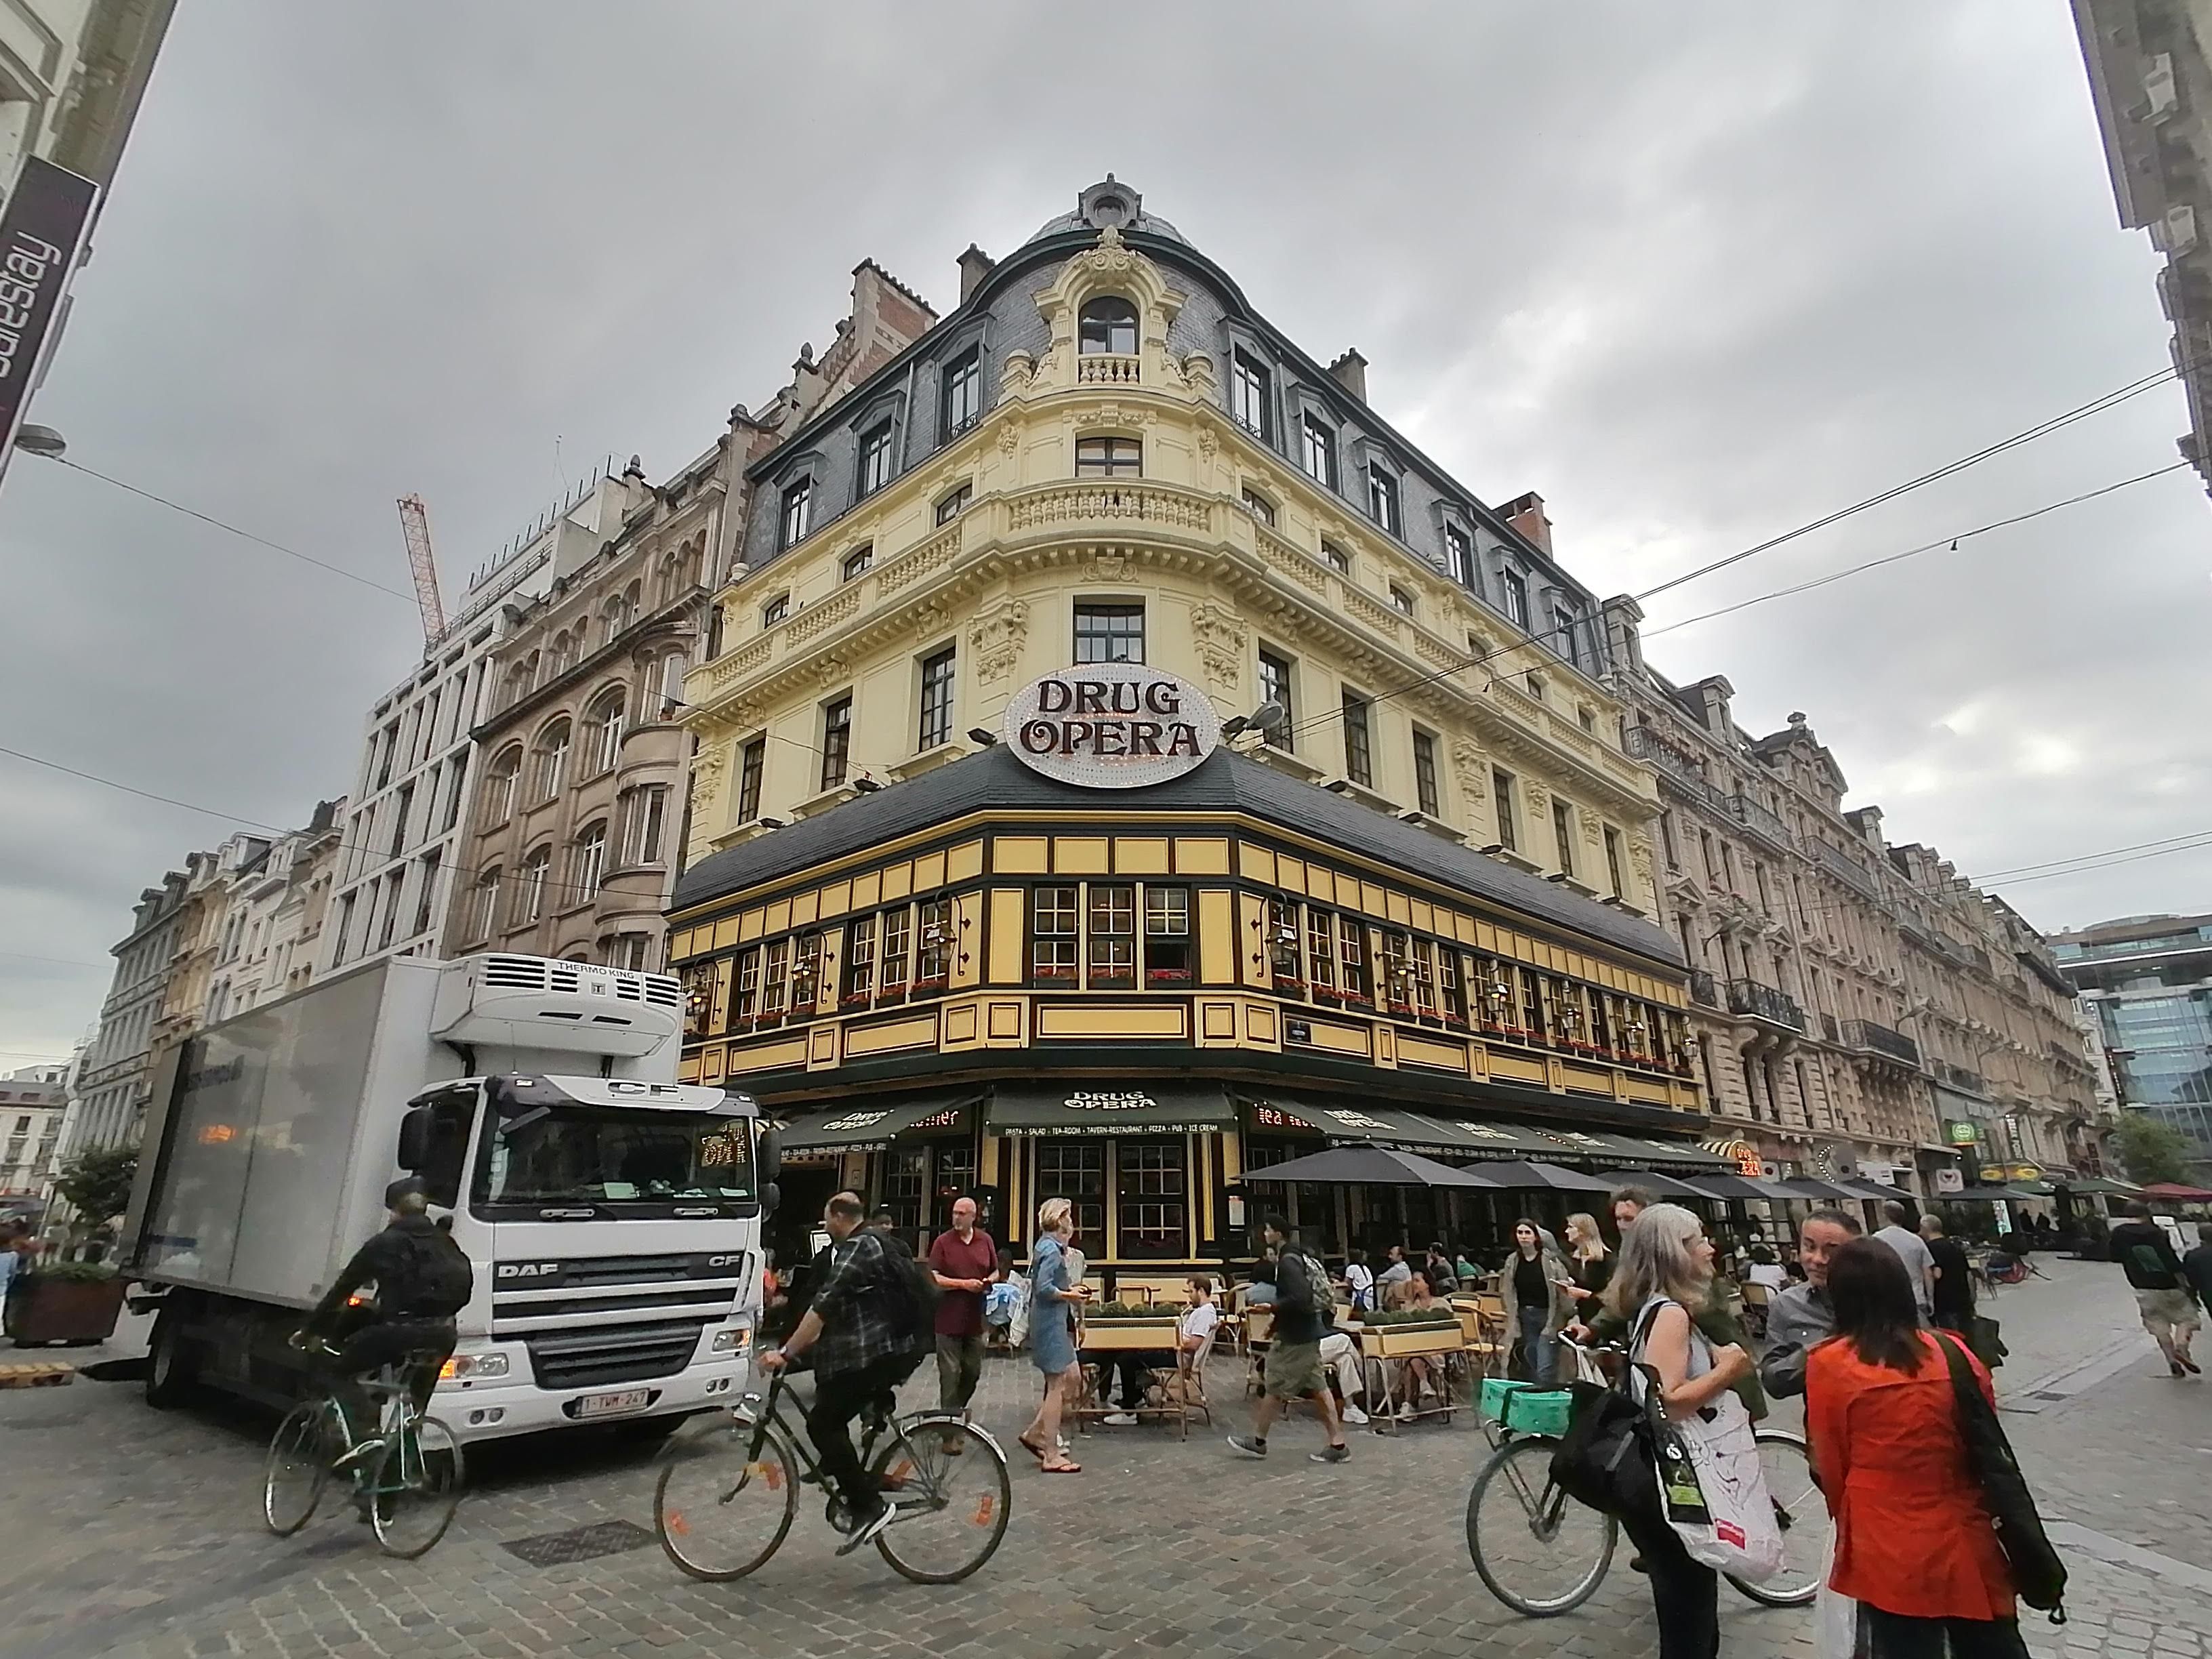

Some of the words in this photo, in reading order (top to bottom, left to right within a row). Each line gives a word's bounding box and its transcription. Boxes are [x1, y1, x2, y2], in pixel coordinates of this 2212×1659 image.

[1038, 680, 1181, 714] DRUG
[1020, 719, 1202, 756] OPERA
[558, 962, 607, 975] THERMO
[609, 970, 634, 979] KING
[1064, 1099, 1157, 1109] OPERA
[1073, 1091, 1145, 1101] DRUG
[1005, 1128, 1023, 1136] PASTA
[1052, 1126, 1081, 1134] TEA-ROOM
[1086, 1125, 1143, 1134] TAVERN-RESTAURANT
[1189, 1124, 1197, 1132] ICE
[1199, 1124, 1218, 1132] CREAM
[497, 1263, 558, 1278] DAF
[708, 1255, 741, 1267] CF
